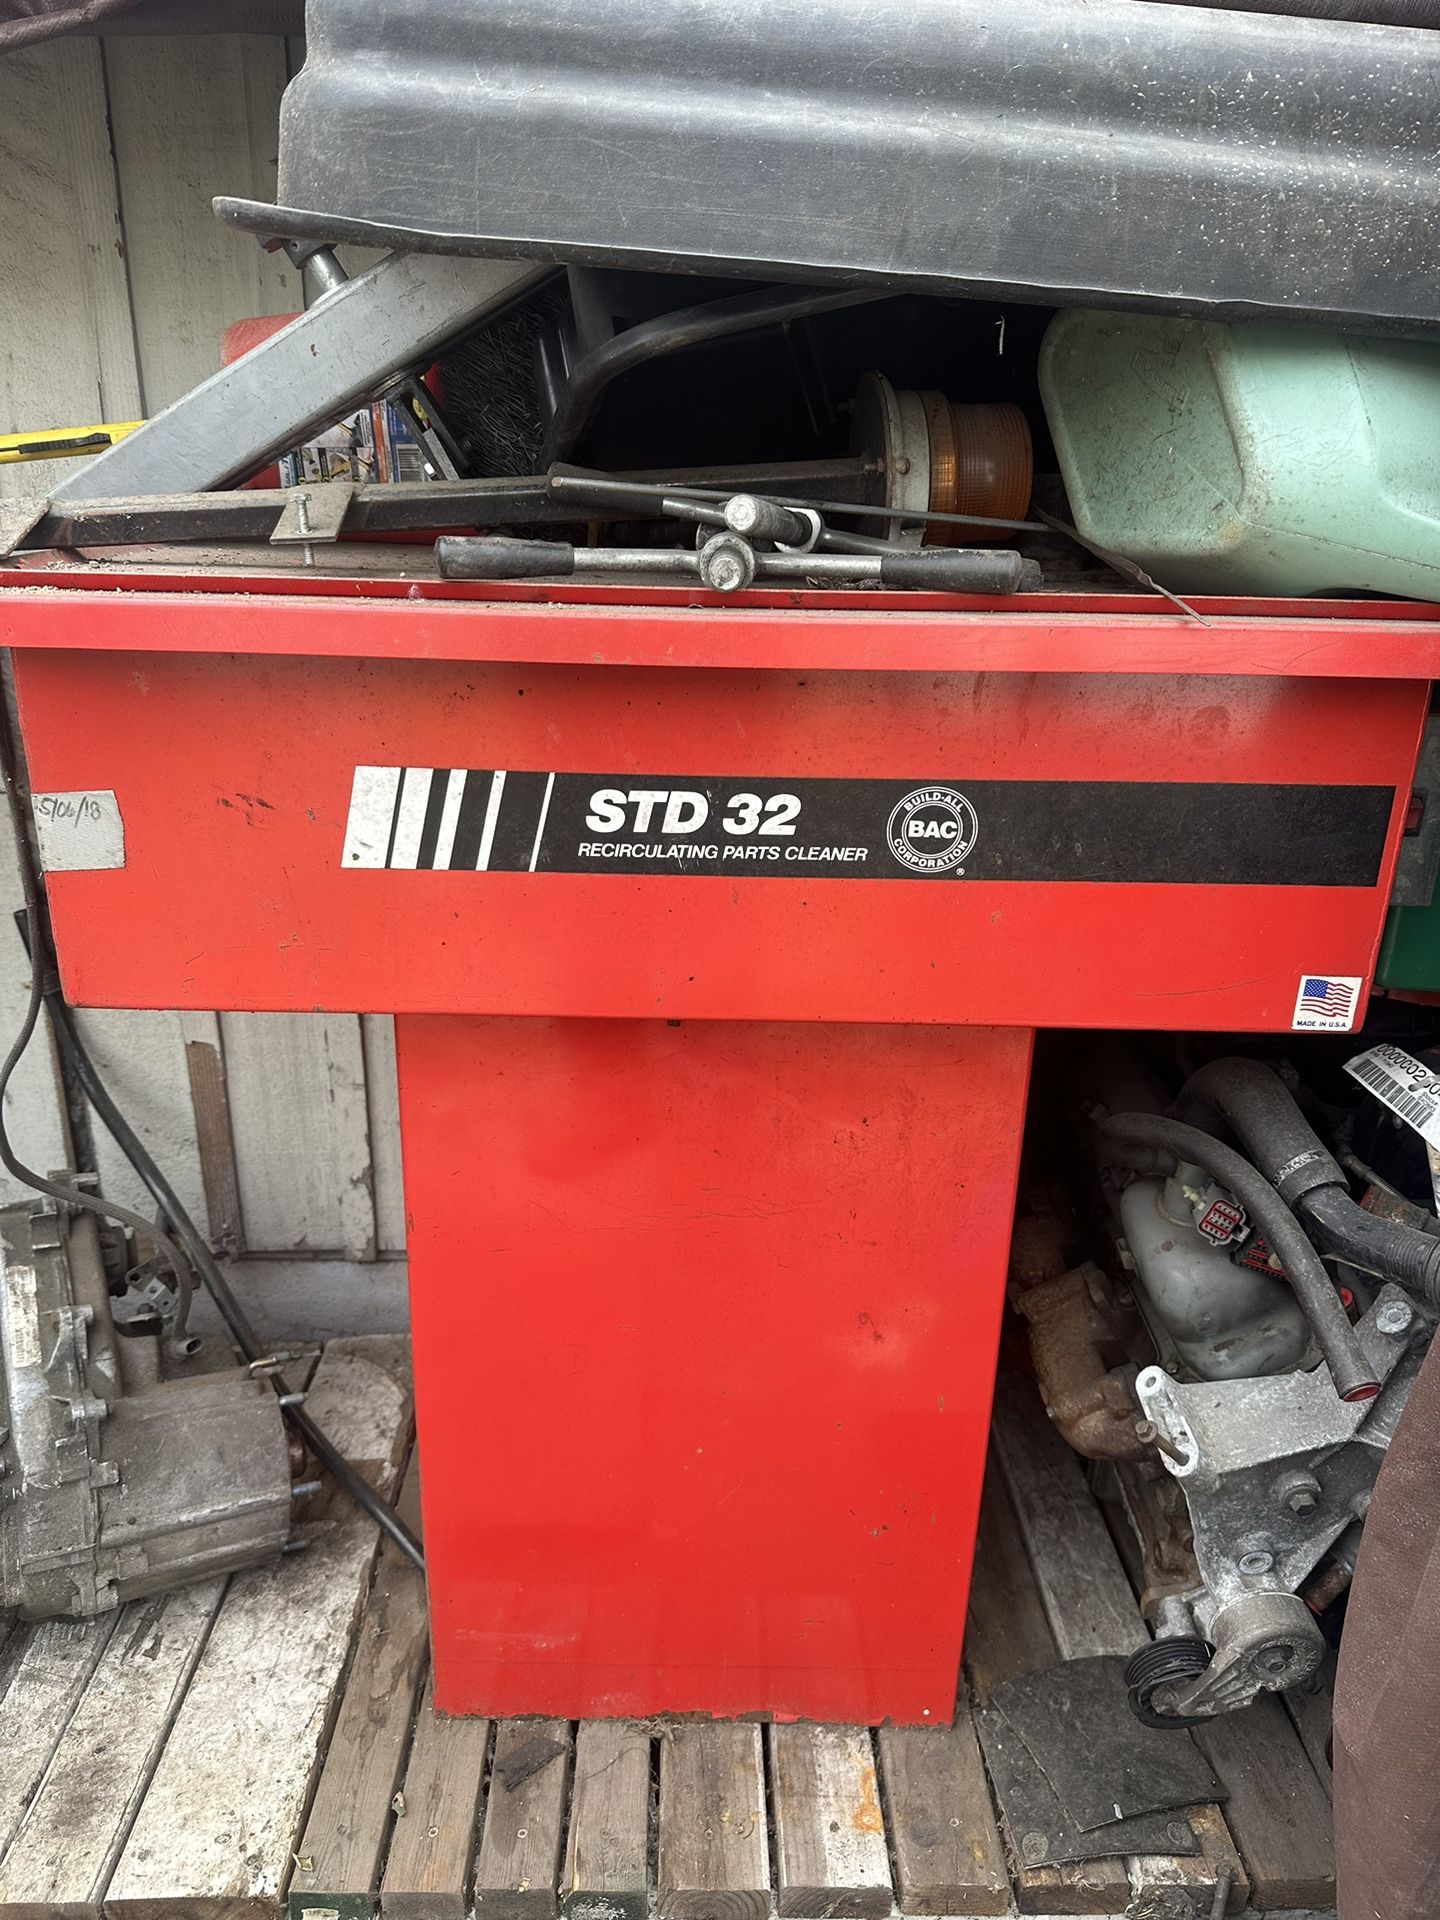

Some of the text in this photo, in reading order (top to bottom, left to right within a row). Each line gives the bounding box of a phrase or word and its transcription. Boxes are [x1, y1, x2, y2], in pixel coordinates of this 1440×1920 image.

[585, 789, 802, 836] STD 32
[903, 791, 964, 813] BUILD-ALL
[908, 820, 958, 839] BAC
[577, 842, 869, 862] RECIRCULATING PARTS CLEANER
[893, 838, 968, 867] CORPORATION
